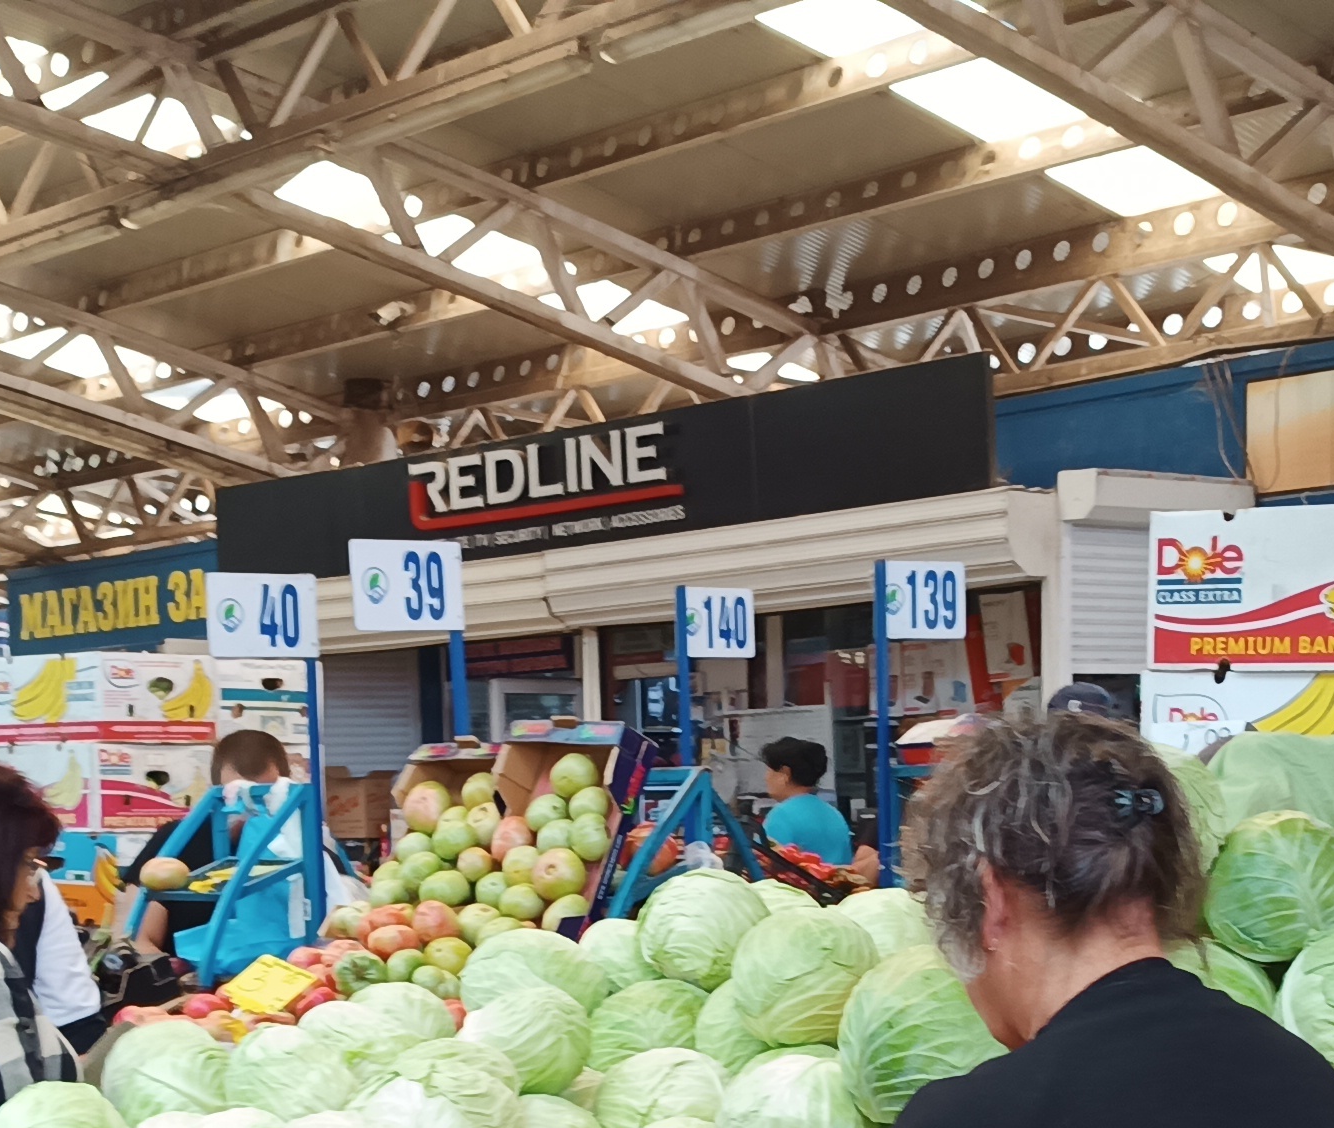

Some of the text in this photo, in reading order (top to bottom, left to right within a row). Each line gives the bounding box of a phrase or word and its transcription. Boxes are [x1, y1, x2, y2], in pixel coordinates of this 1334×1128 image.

[407, 421, 668, 513] REDLINE
[403, 551, 446, 620] 39
[1156, 535, 1244, 580] Dole
[20, 576, 161, 640] МАГАЗИН
[259, 583, 300, 648] 40
[704, 596, 747, 650] 140
[906, 569, 957, 630] 139
[1157, 587, 1242, 603] CLASS EXTRA
[1189, 636, 1292, 656] PREMIUM
